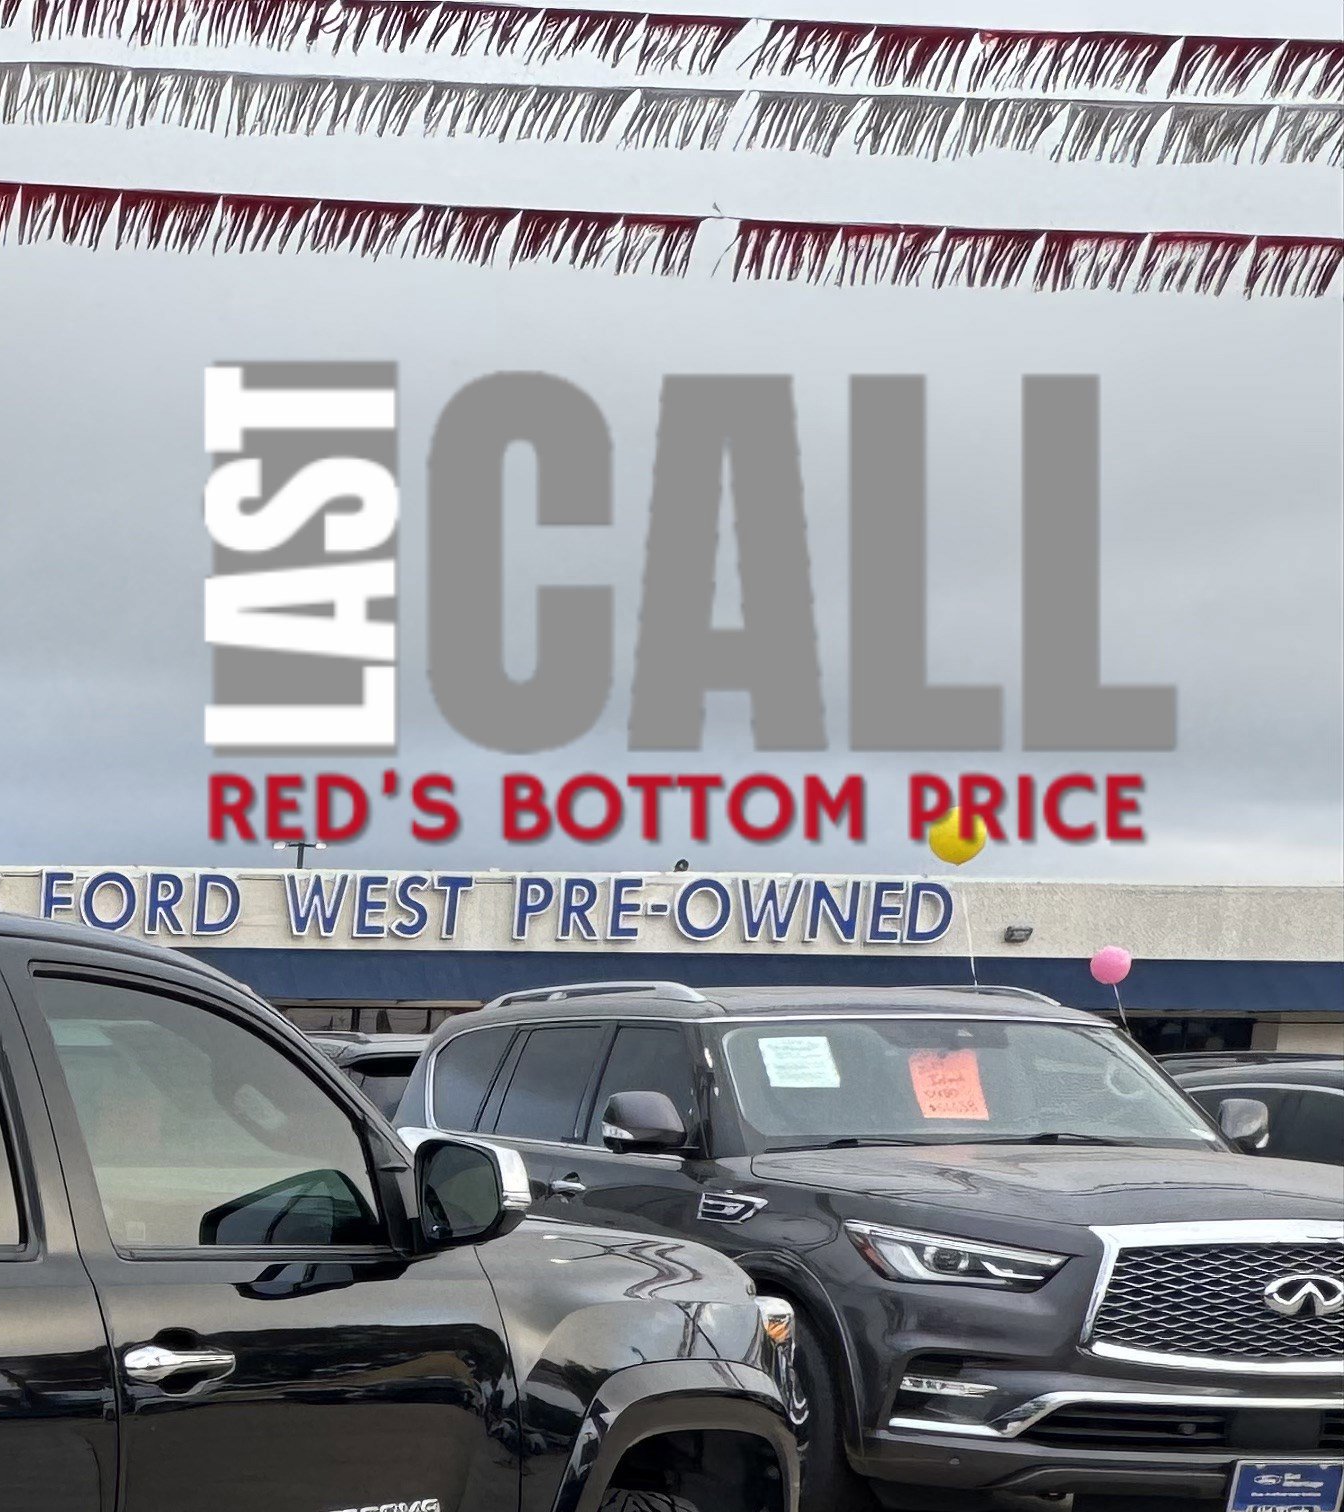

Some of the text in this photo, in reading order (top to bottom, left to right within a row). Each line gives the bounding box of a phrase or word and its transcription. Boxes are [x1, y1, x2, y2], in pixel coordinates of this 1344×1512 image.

[41, 869, 241, 935] FORD
[285, 873, 474, 940] WEST
[511, 875, 955, 944] PRE-OWNED
